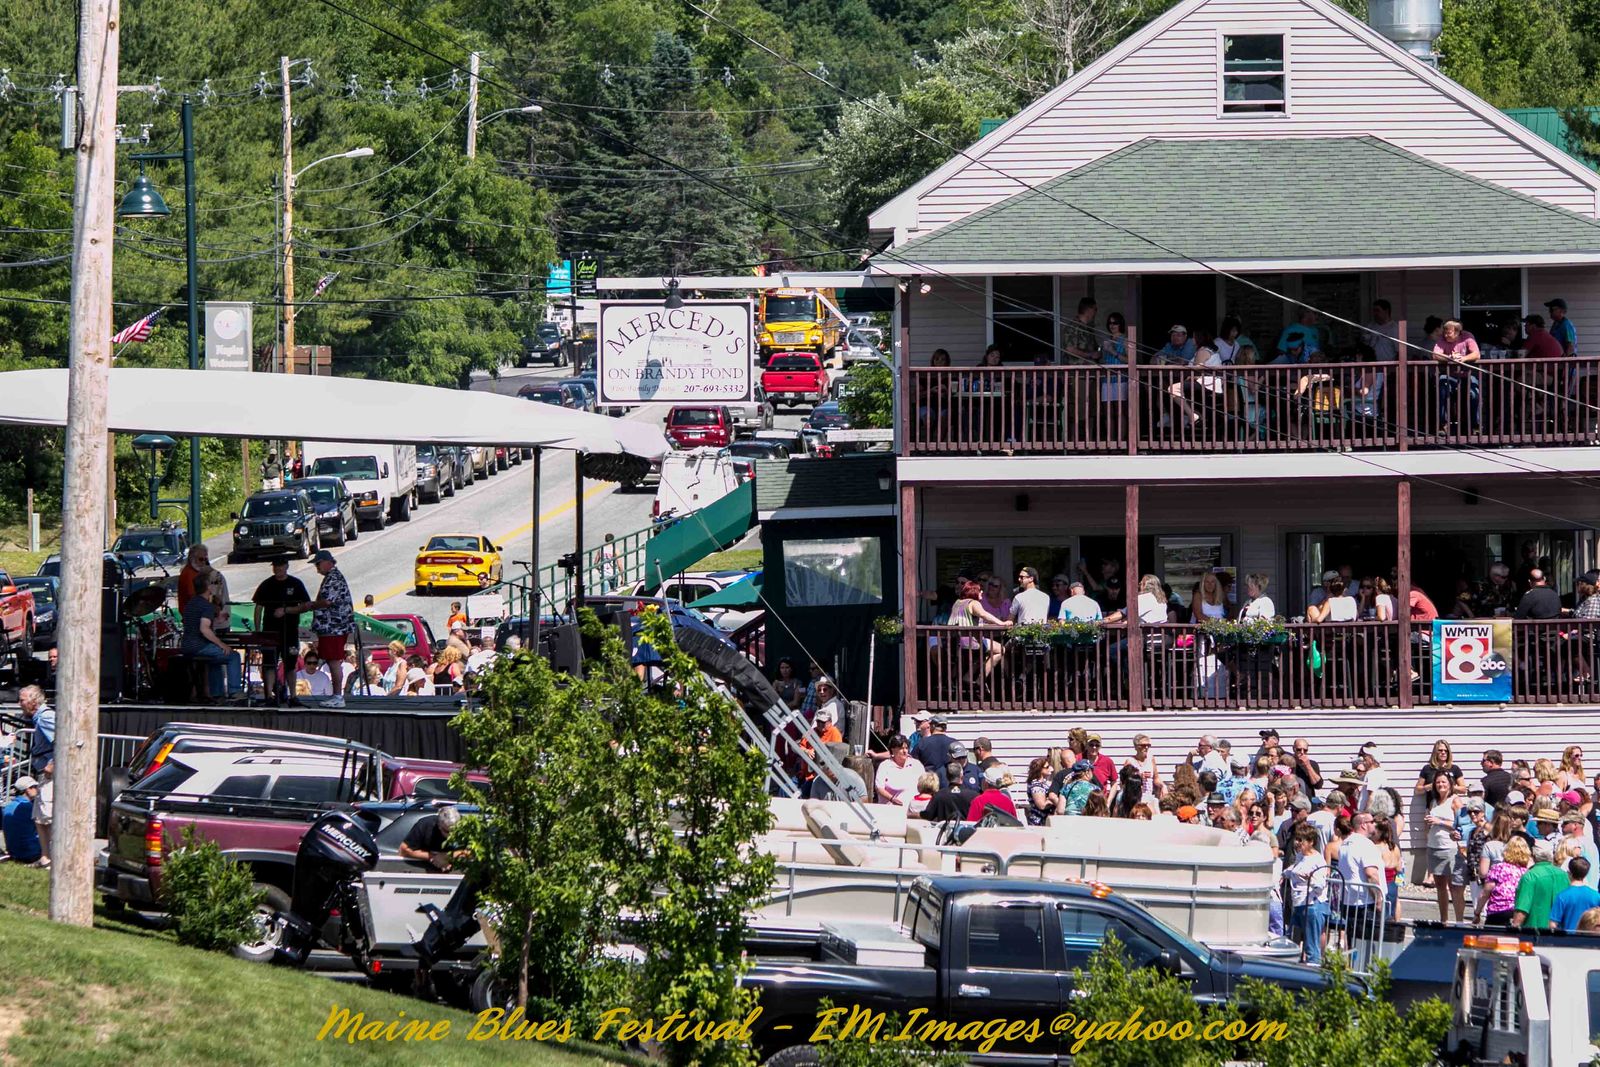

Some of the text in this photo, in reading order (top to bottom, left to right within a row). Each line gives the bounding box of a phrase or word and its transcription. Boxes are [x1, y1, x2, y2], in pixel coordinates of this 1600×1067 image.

[605, 309, 746, 356] MERCED'S
[608, 367, 744, 380] ON BRANDY POND
[683, 384, 745, 393] 207-693-5332
[1445, 627, 1489, 637] WMTW
[1447, 638, 1485, 680] 8
[1480, 658, 1506, 671] abc
[321, 824, 372, 858] MERCURY
